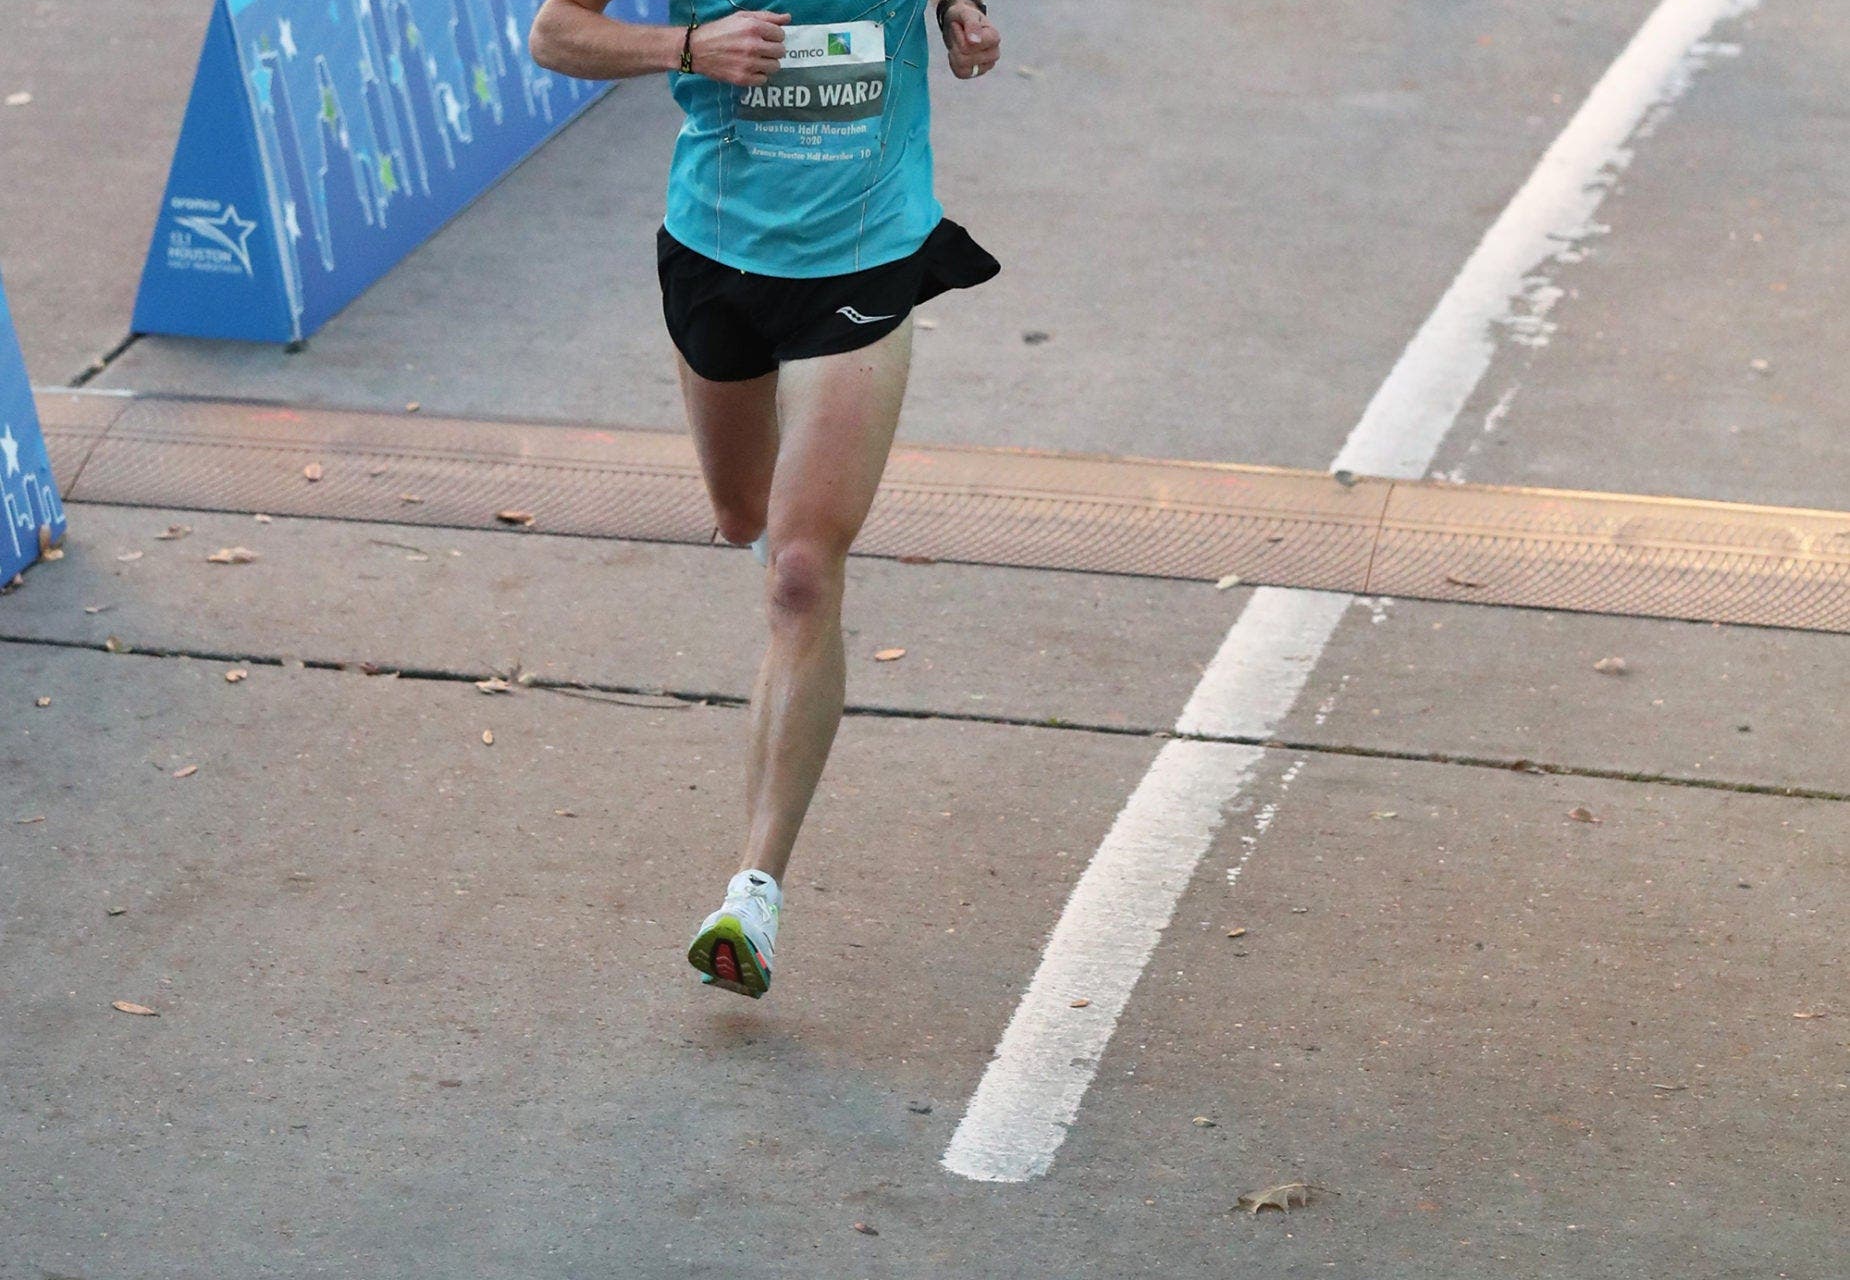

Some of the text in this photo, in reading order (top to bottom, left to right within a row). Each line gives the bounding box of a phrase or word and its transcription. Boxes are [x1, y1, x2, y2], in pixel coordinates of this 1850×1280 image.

[785, 46, 825, 60] ramco
[740, 79, 884, 108] JARED WARD
[754, 122, 867, 136] Houston Half Marathon
[799, 134, 823, 146] 2020
